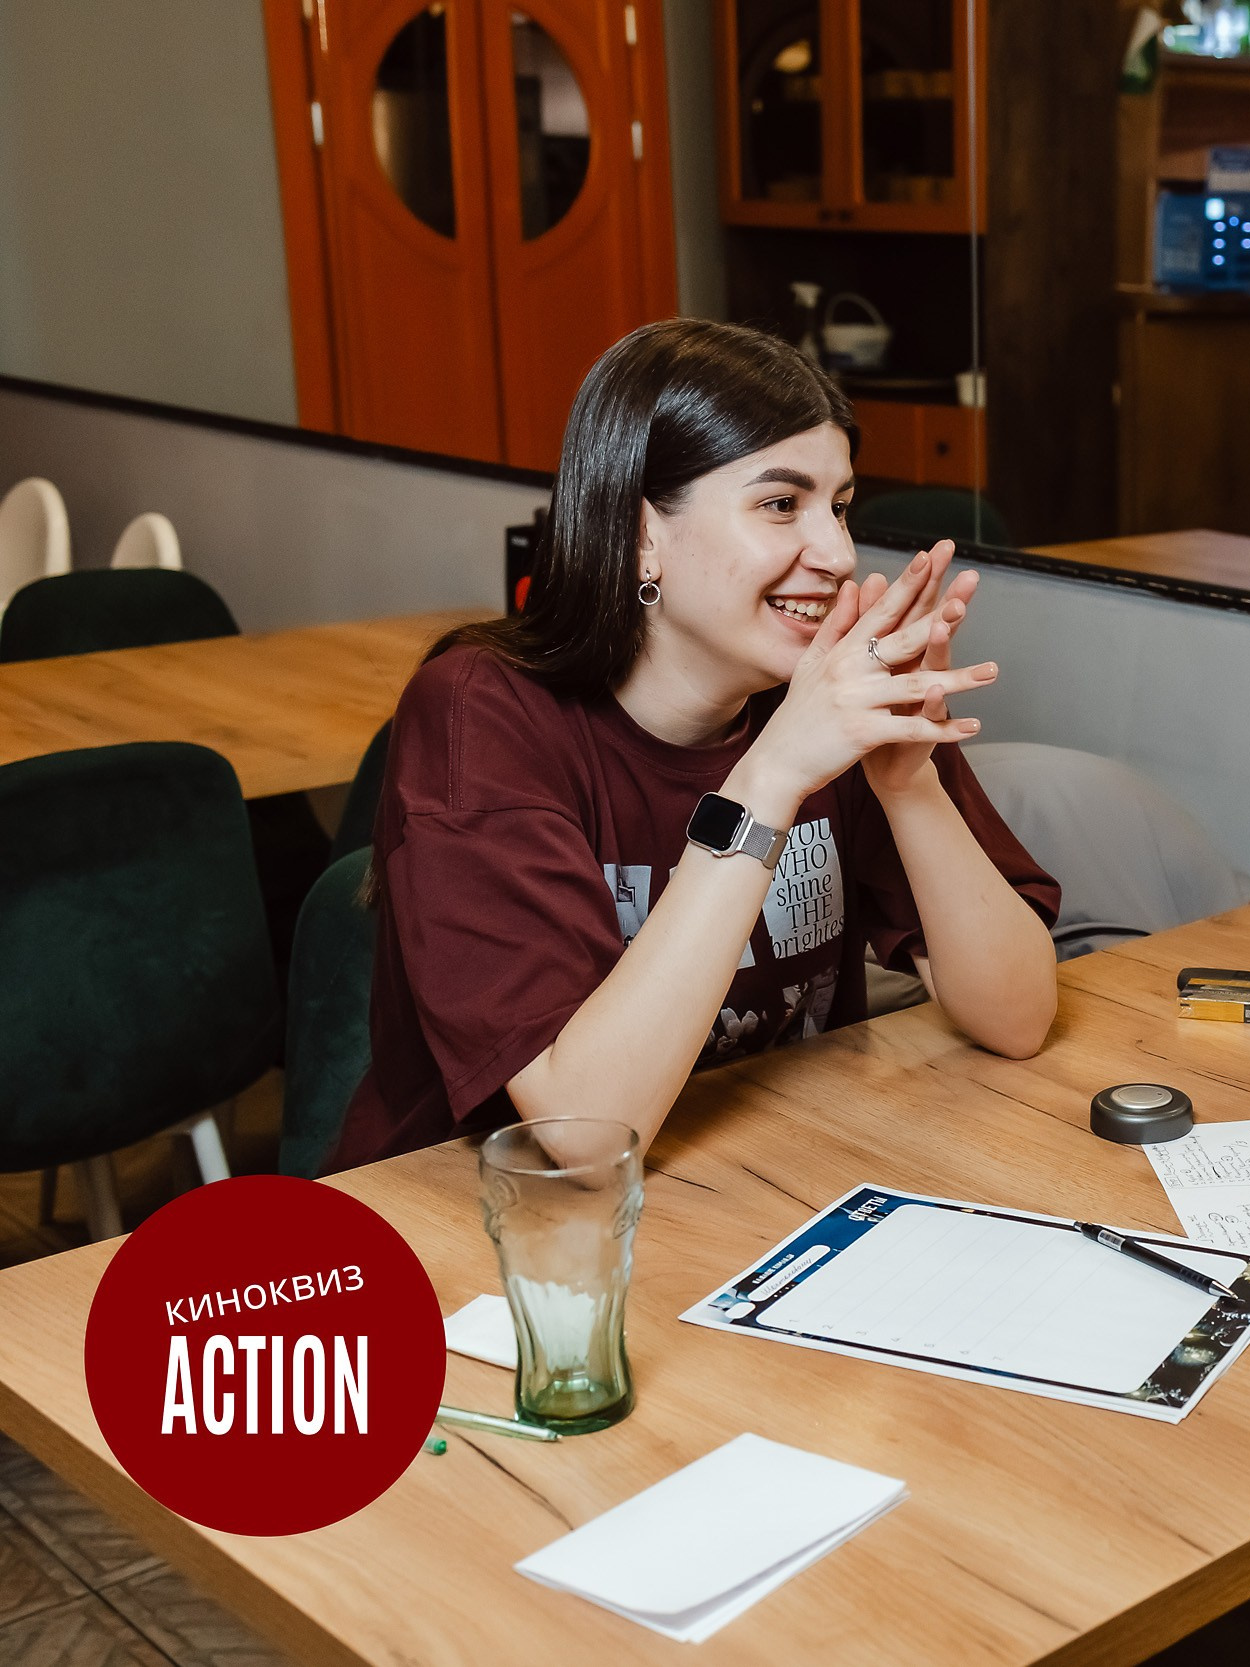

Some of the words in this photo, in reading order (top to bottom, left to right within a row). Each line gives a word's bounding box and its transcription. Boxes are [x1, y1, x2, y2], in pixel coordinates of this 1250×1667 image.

[787, 818, 832, 851] YOU
[776, 873, 833, 907] shine
[786, 894, 833, 930] THE
[848, 1196, 888, 1221] ОТВЕТЫ
